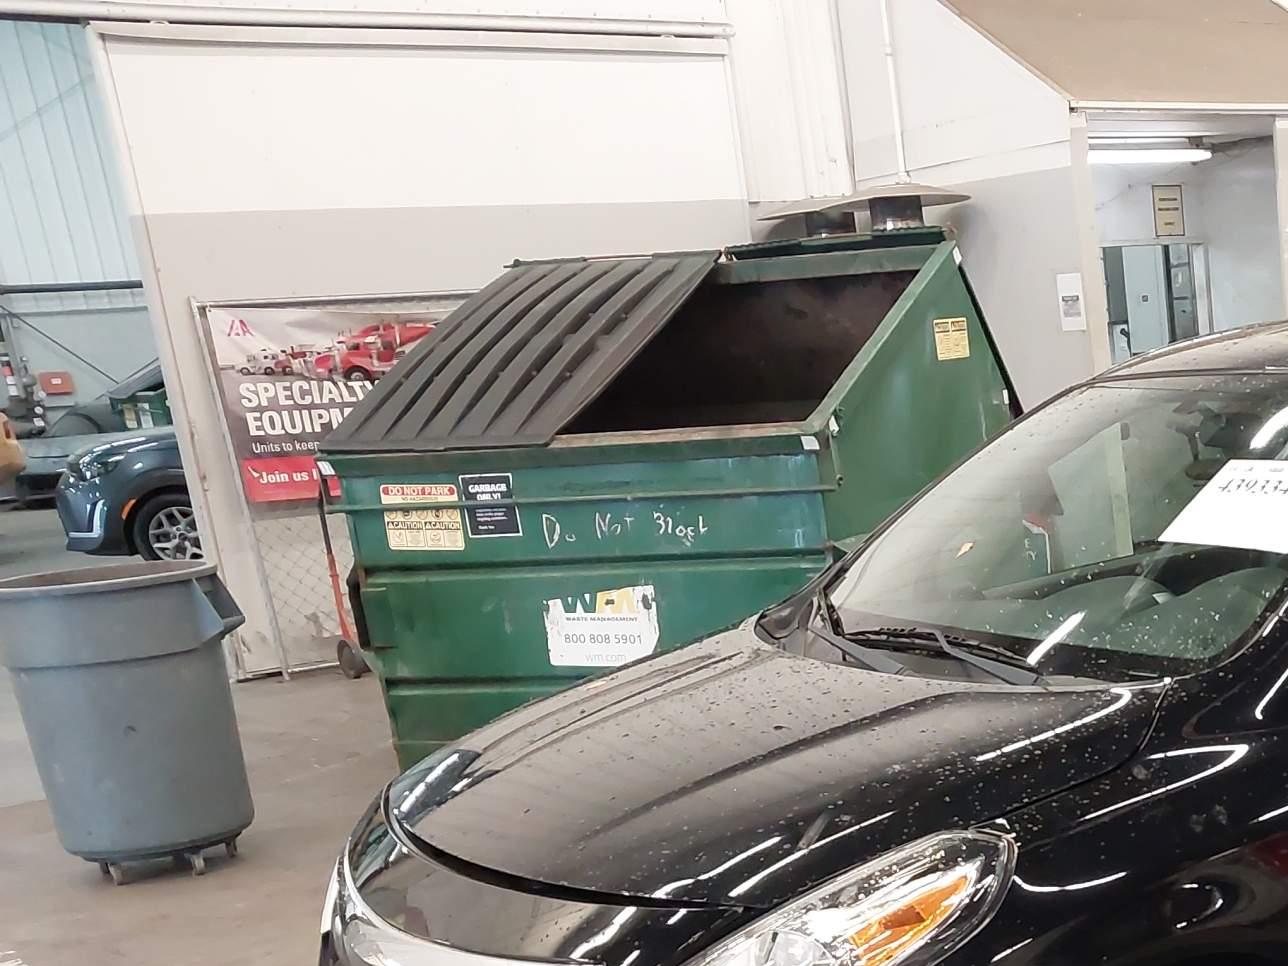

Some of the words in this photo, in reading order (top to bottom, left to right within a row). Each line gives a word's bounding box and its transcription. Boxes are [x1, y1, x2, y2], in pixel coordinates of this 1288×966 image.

[246, 407, 353, 436] EQUIPM
[252, 441, 281, 453] Units
[282, 442, 293, 452] to
[259, 470, 290, 484] Join
[292, 471, 310, 482] us
[388, 486, 401, 495] DO
[403, 486, 423, 495] NOT
[425, 486, 450, 495] PARK
[468, 483, 507, 493] GARBAGE
[393, 521, 422, 529] CAUTION
[431, 521, 460, 529] CAUTION
[564, 633, 586, 644] 800
[589, 633, 611, 644] 808
[614, 633, 642, 644] 5901
